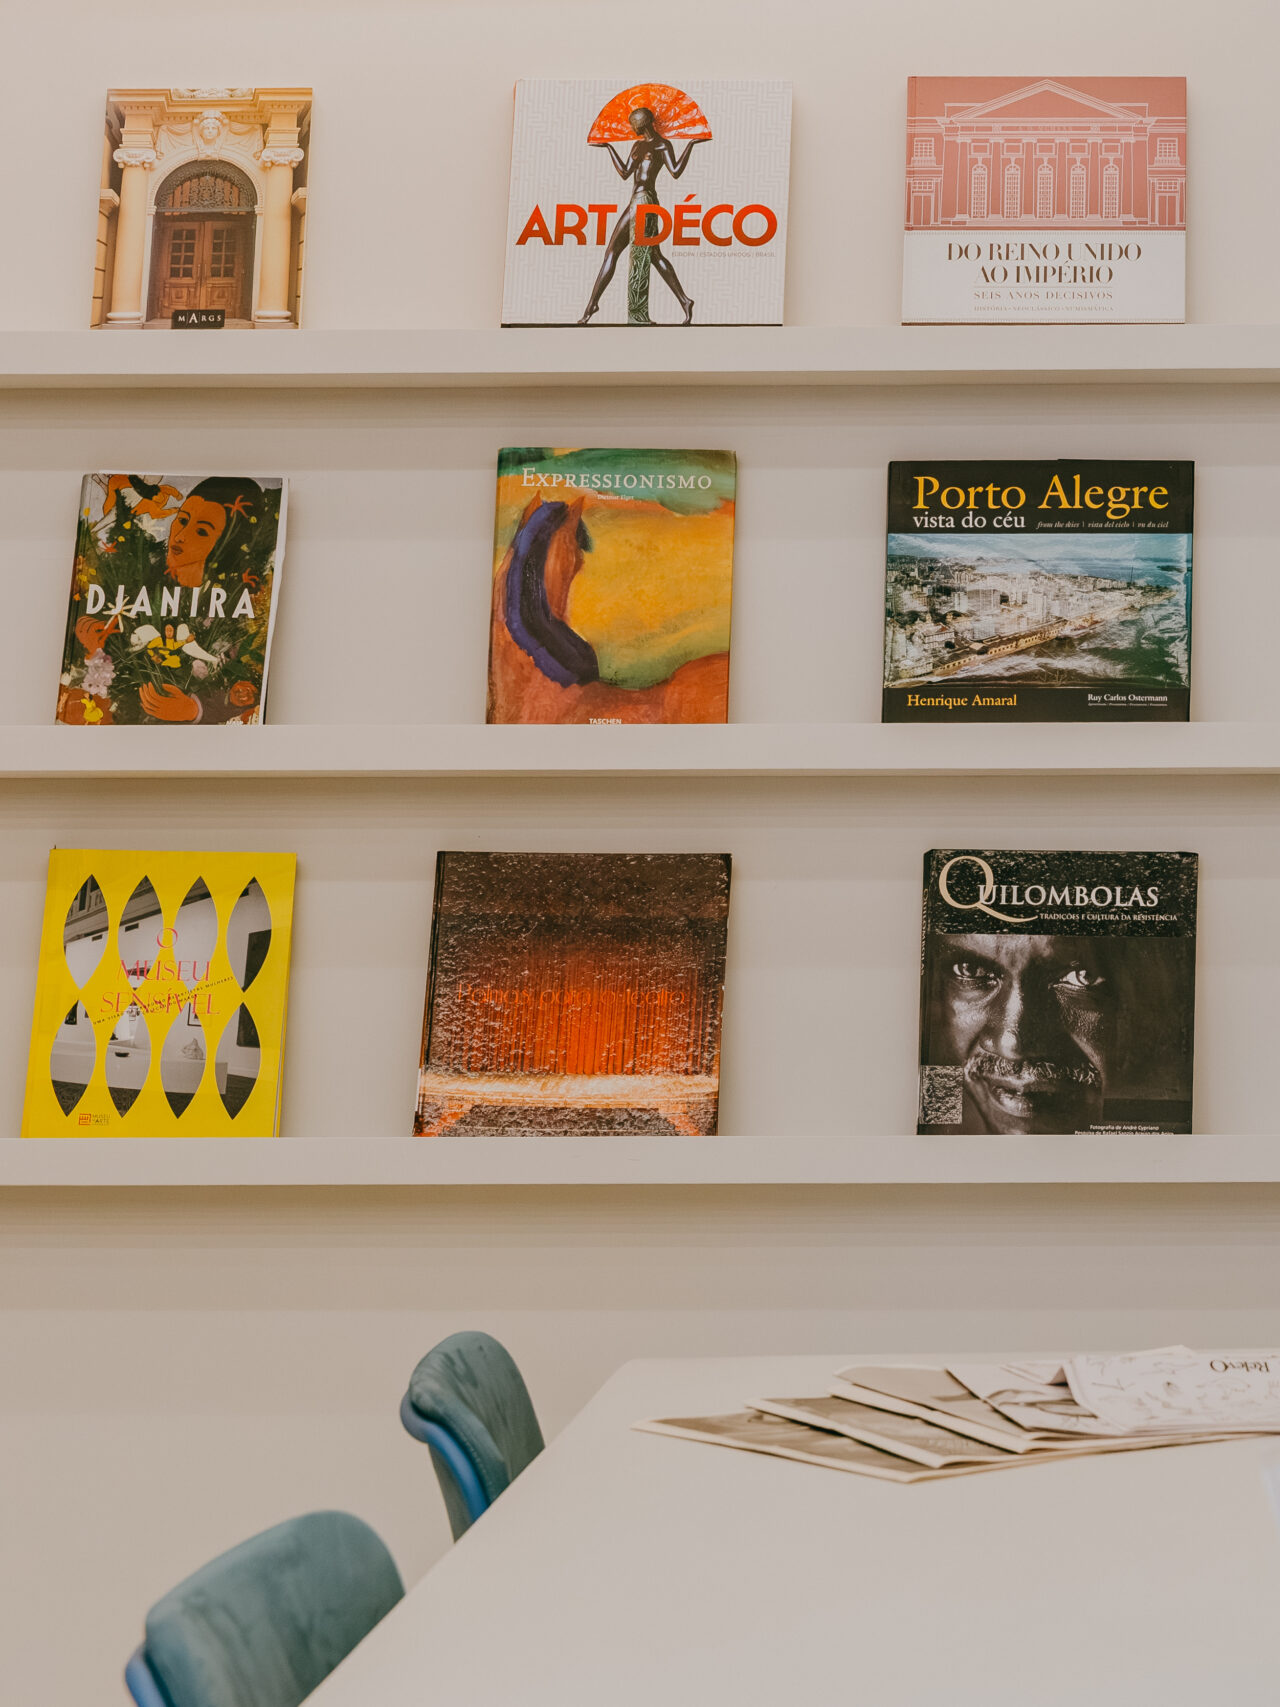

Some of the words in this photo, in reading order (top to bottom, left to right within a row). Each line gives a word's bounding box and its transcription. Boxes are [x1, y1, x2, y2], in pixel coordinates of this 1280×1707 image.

[515, 203, 618, 245] ART
[633, 193, 778, 247] DÉCO
[947, 243, 982, 261] DO
[989, 243, 1060, 261] REINO
[1067, 243, 1142, 261] UNIDO
[974, 266, 1008, 284] AO
[1016, 260, 1113, 284] IMPÉRIO
[974, 291, 1001, 300] SEIS
[1009, 291, 1040, 300] ANOS
[1046, 291, 1113, 300] DECISIVOS
[521, 466, 712, 490] EXPRESSIONISMO
[912, 475, 1027, 510] Porto
[1037, 473, 1169, 520] Alegre
[912, 511, 955, 529] vista
[962, 511, 987, 529] do
[993, 510, 1027, 529] céu
[86, 583, 255, 619] DJANIRA
[906, 693, 968, 710] Henrique
[971, 693, 1017, 706] Amaral
[1087, 693, 1102, 703] Ruy
[1103, 693, 1127, 701] Carlos
[1127, 693, 1168, 702] Ostermann
[938, 855, 1160, 923] QUILOMBOLAS
[1040, 912, 1080, 920] TRADIÇÕES
[1087, 913, 1120, 921] CULTURA
[1133, 912, 1178, 921] RESISTÊNCIA
[156, 927, 178, 948] O
[117, 959, 210, 981] MUSEU
[100, 988, 220, 1014] SENSÍVEL
